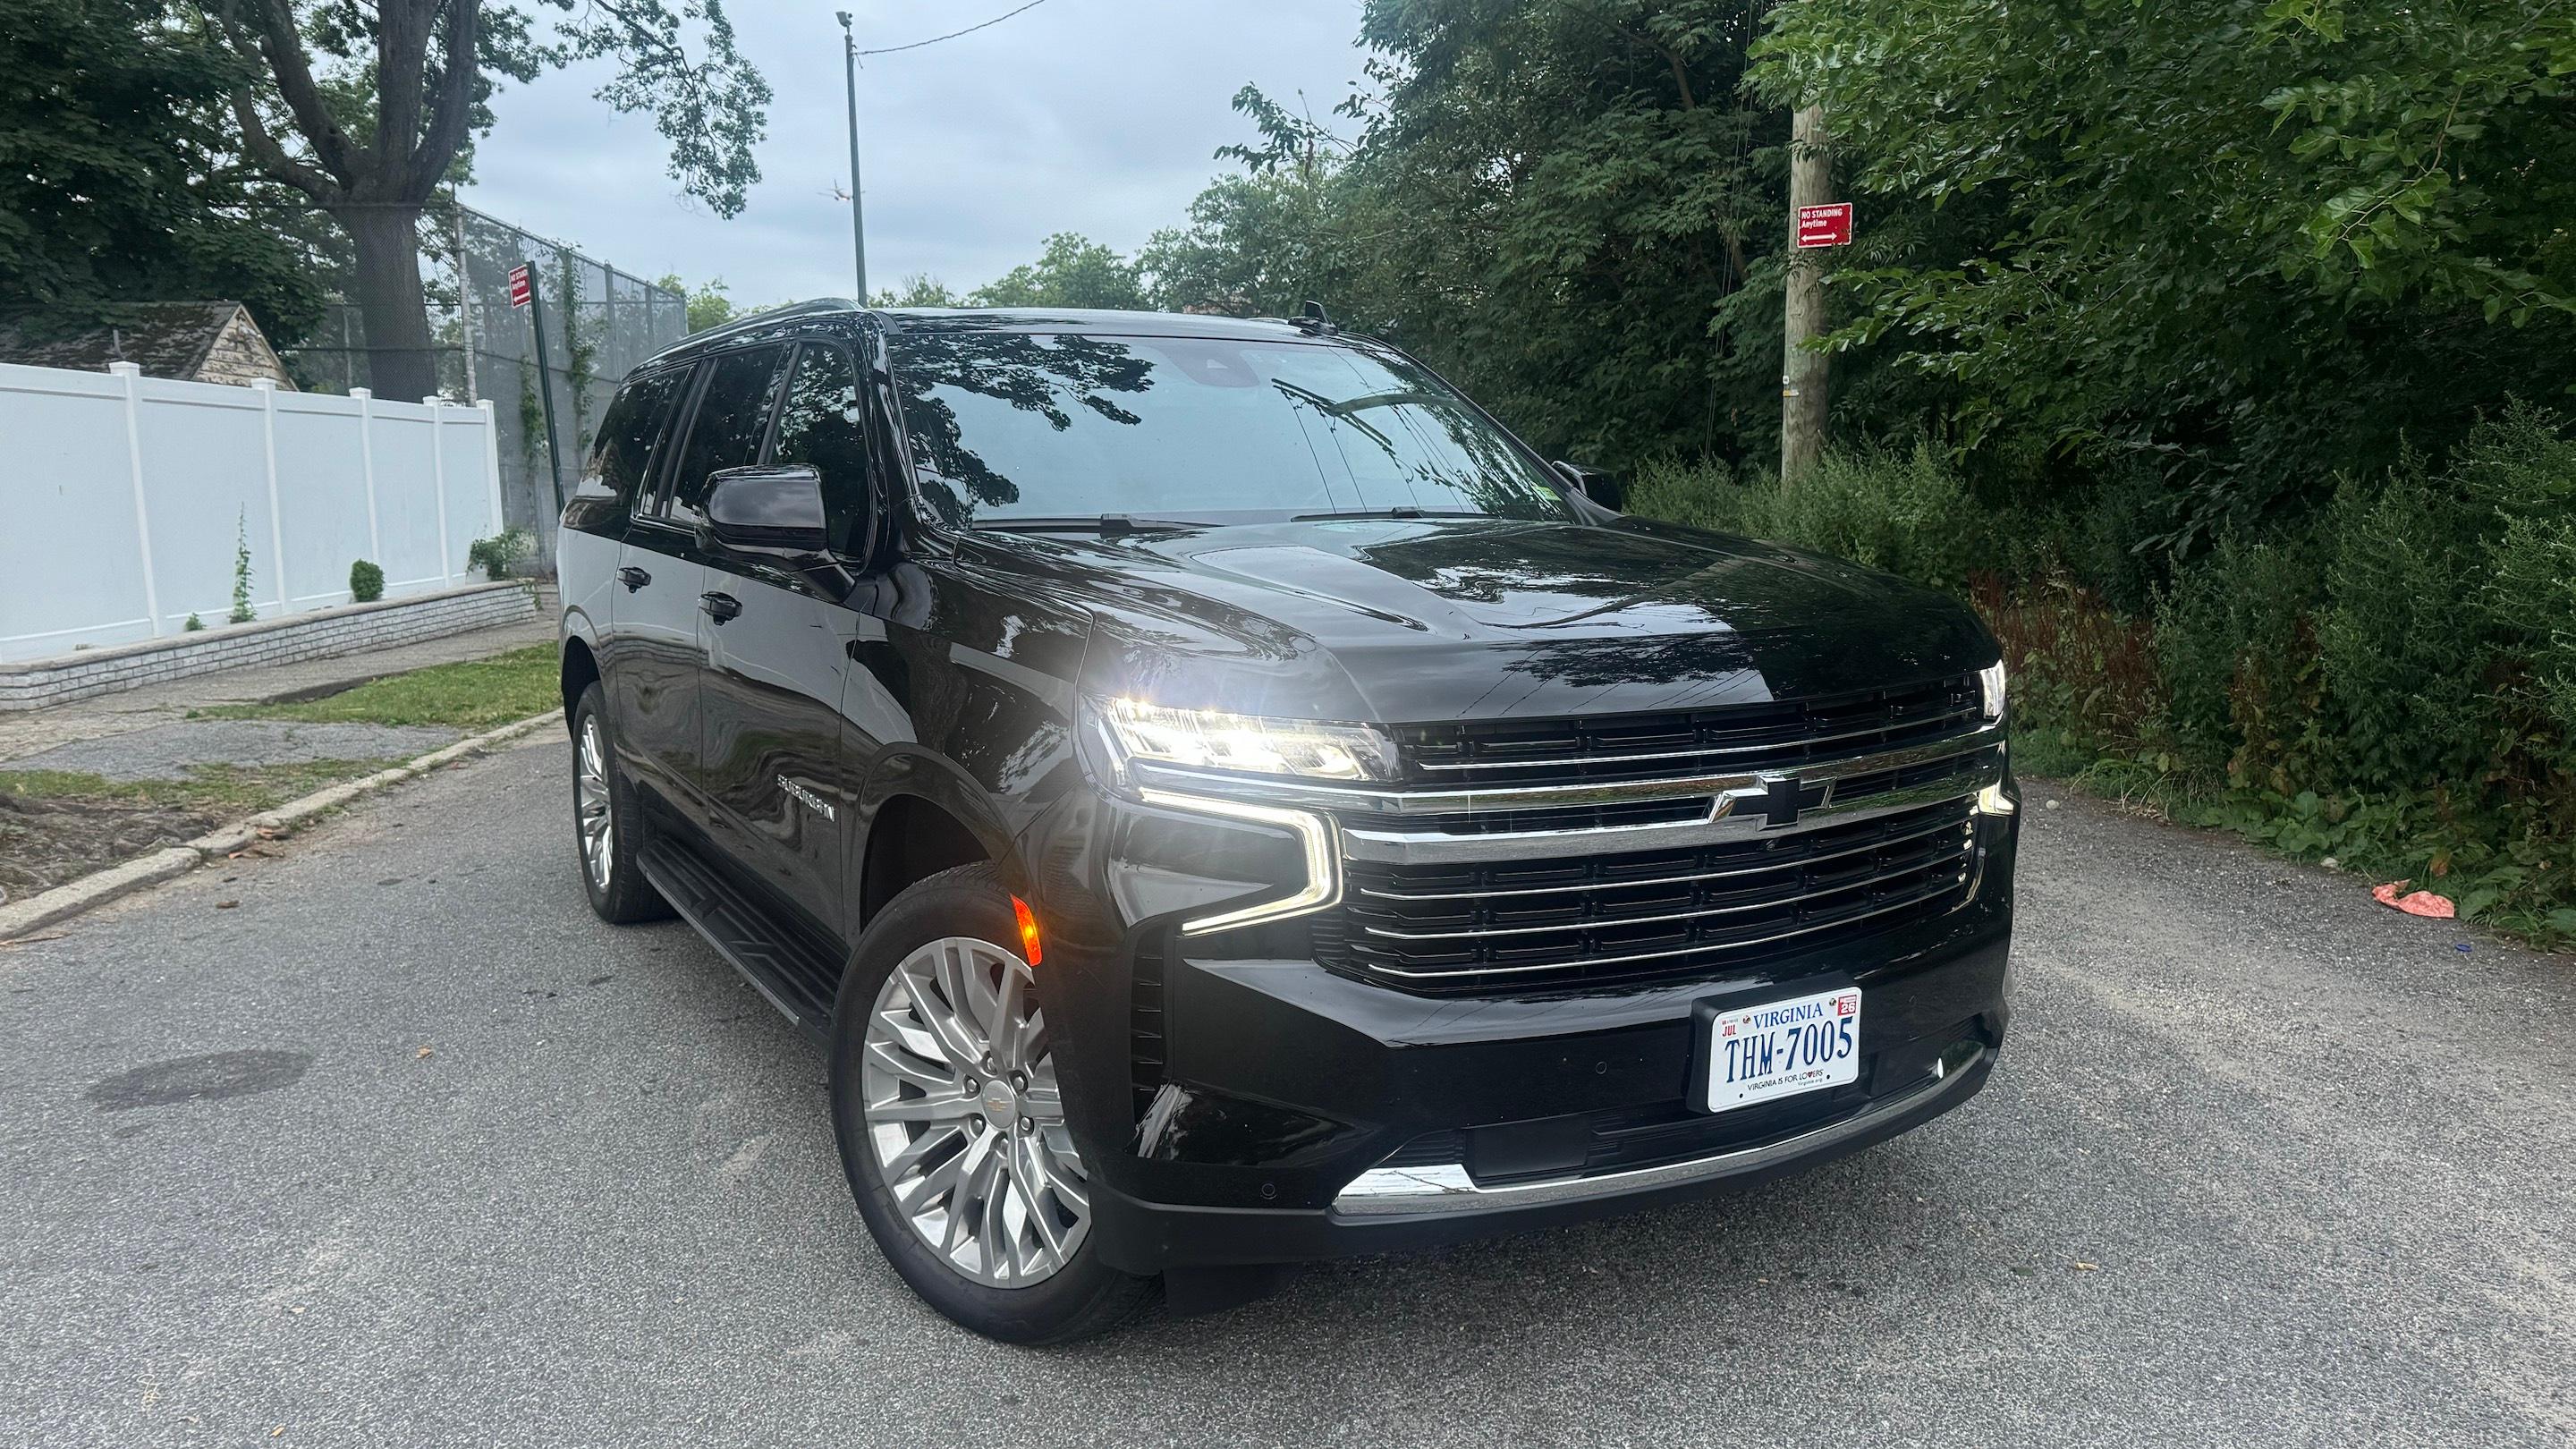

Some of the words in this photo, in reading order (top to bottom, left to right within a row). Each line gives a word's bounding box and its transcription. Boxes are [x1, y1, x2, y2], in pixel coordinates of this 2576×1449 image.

[1801, 210, 1810, 219] NO
[1811, 208, 1843, 218] STANDING
[1801, 219, 1827, 229] Anytime
[1841, 1002, 1855, 1013] 26
[1754, 1002, 1824, 1029] VIRGINIA
[1722, 1024, 1737, 1037] JUL
[1724, 1016, 1853, 1083] THM-7005
[1747, 1079, 1777, 1091] VIRGINIA
[1777, 1077, 1784, 1085] IS
[1784, 1074, 1798, 1083] FOR
